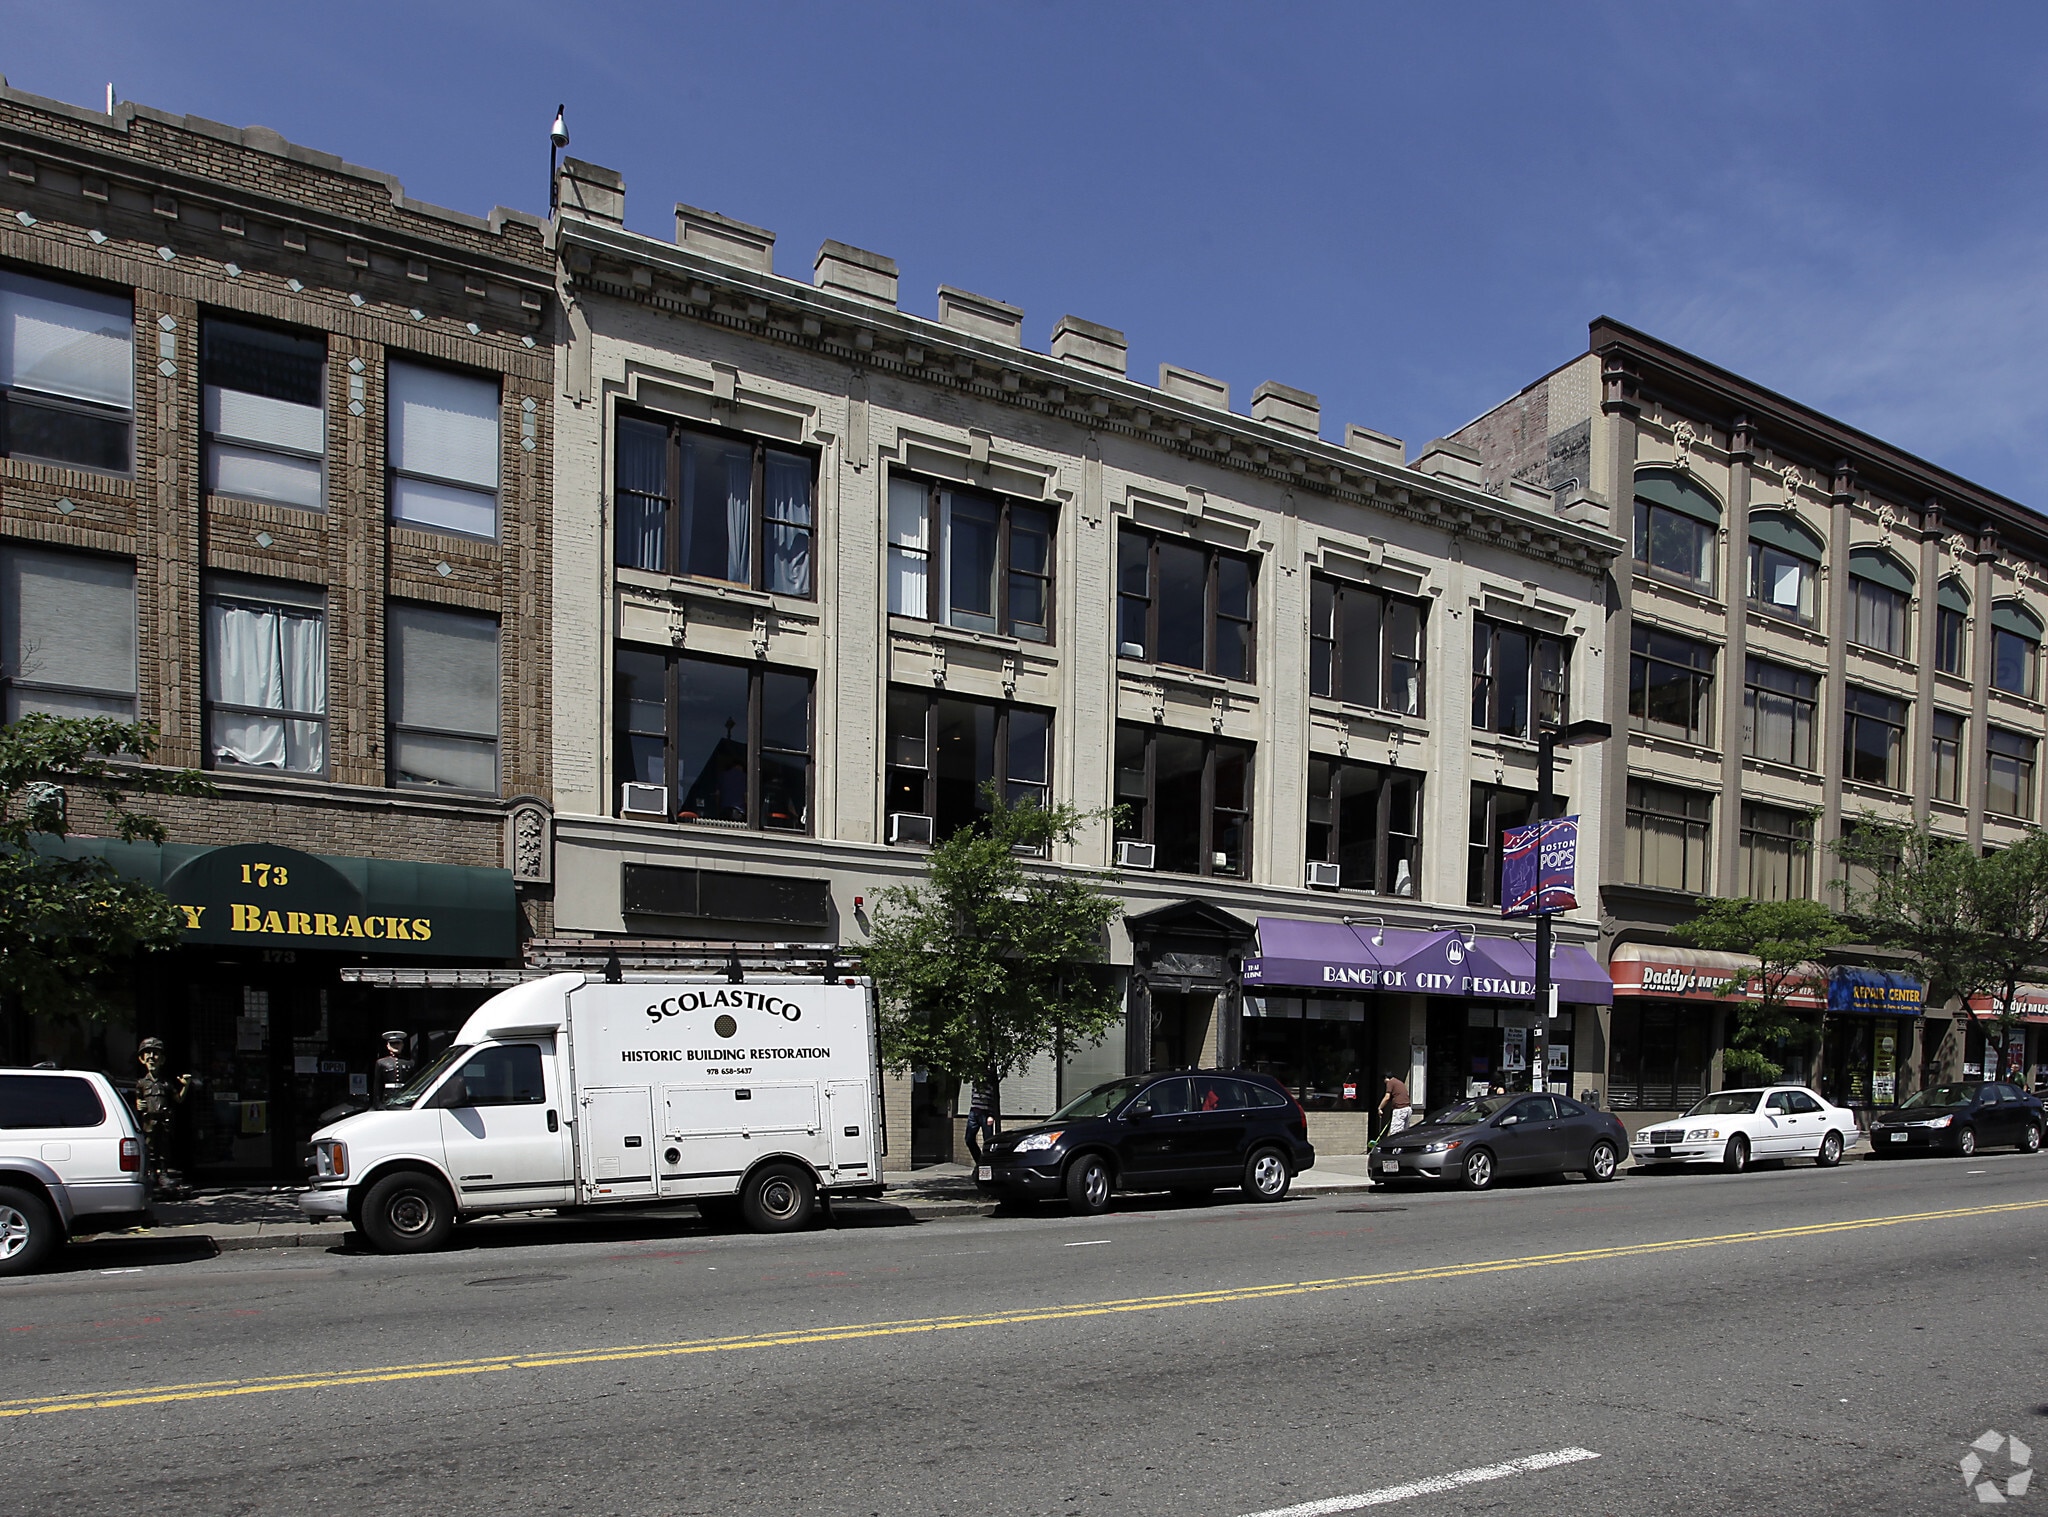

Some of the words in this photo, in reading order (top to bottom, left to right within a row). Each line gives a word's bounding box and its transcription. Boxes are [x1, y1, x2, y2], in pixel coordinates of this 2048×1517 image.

[1541, 840, 1576, 853] BOSTON
[1540, 848, 1575, 870] POPS
[241, 863, 289, 888] 173
[230, 903, 432, 941] BARRACKS
[261, 950, 297, 964] 173
[1323, 966, 1407, 987] BANGKOK
[1416, 972, 1455, 989] CITY
[1462, 976, 1560, 997] RESTAURAT
[1853, 986, 1885, 1000] REPAIR
[1889, 988, 1921, 1002] CENTER
[646, 989, 802, 1024] SCOLASTICO
[621, 1049, 683, 1062] HISTORIC
[687, 1048, 746, 1061] BUILDING
[750, 1047, 831, 1060] RESTORATION
[323, 1062, 344, 1072] OPEN
